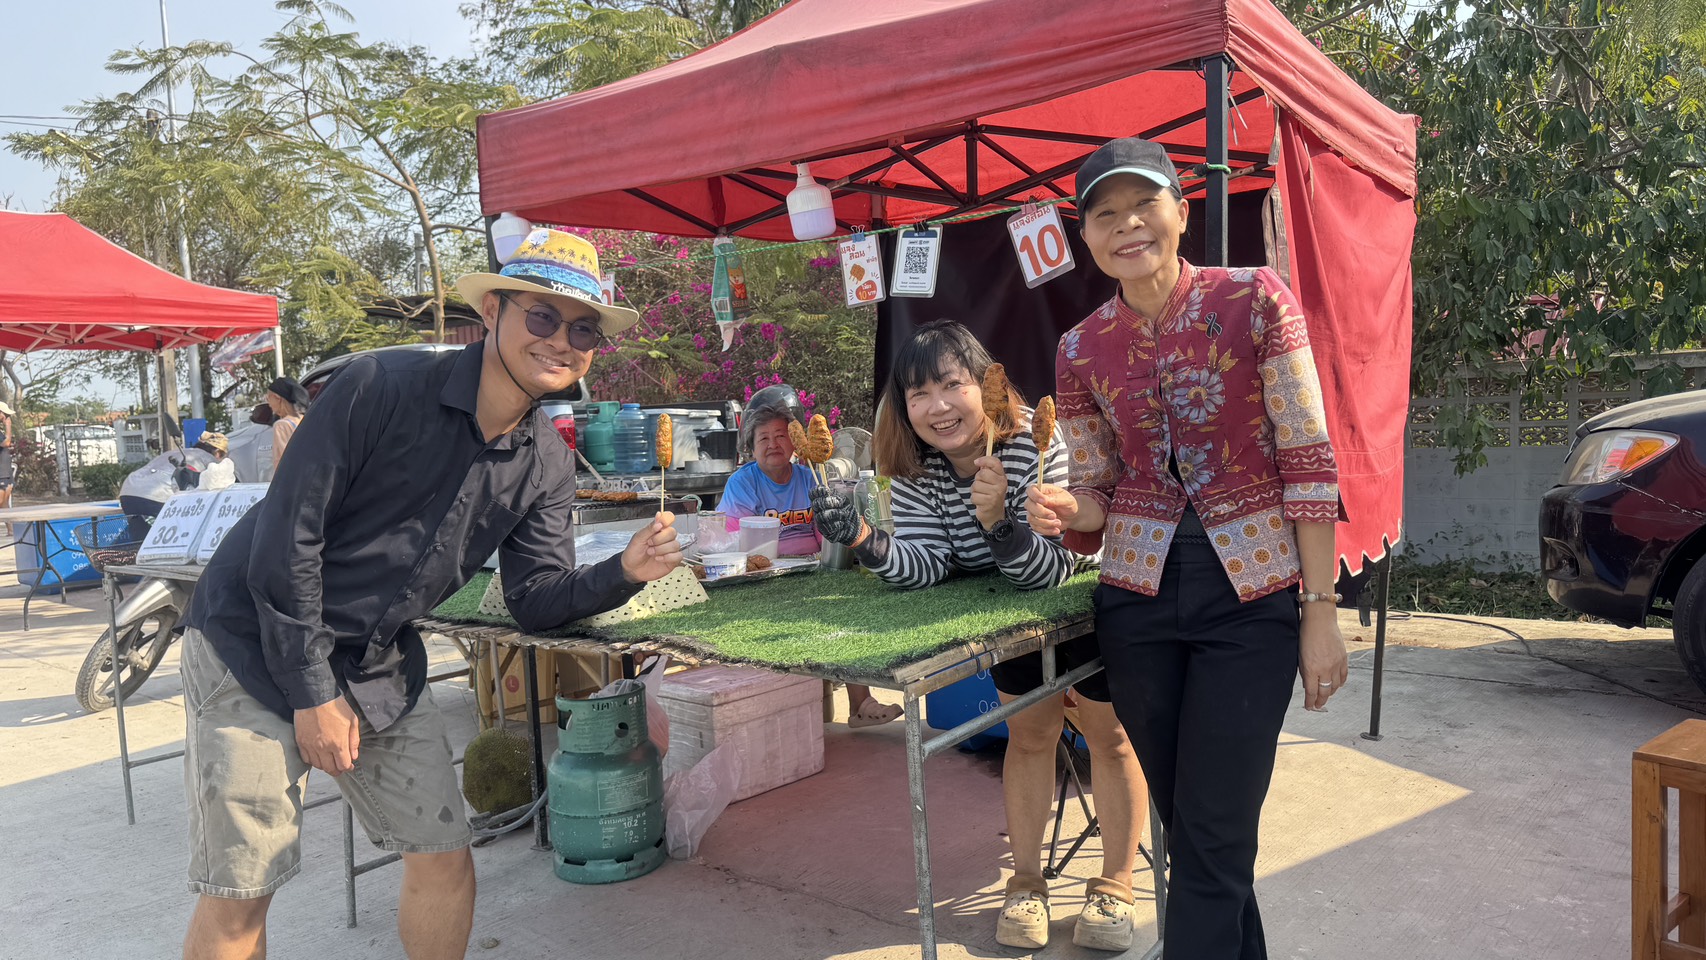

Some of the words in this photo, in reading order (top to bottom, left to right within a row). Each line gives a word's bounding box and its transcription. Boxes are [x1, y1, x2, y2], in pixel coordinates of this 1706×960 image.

[1019, 224, 1065, 276] 10
[550, 281, 592, 301] Thailand
[859, 290, 867, 300] 10
[623, 818, 639, 829] 10.2
